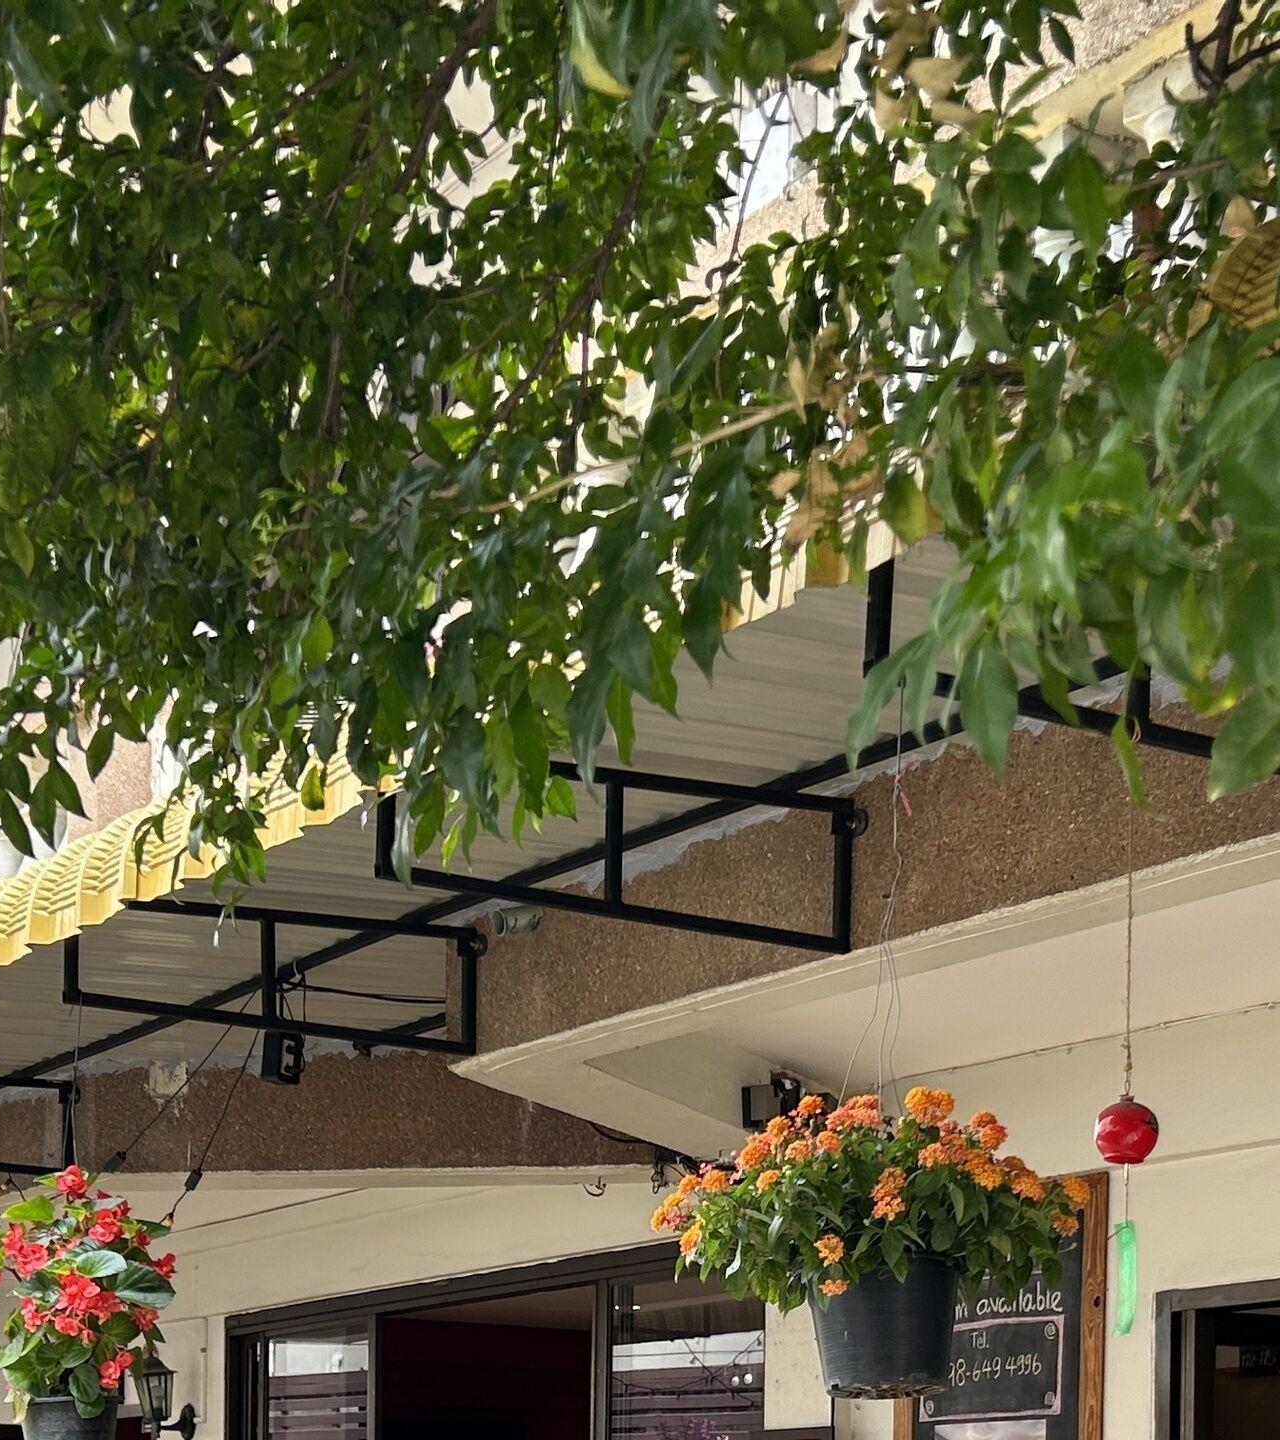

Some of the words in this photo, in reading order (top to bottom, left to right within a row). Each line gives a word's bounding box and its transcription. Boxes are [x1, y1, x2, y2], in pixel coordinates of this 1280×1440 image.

[976, 1281, 1063, 1315] available
[969, 1331, 990, 1349] Tel.
[1004, 1353, 1042, 1377] 4996
